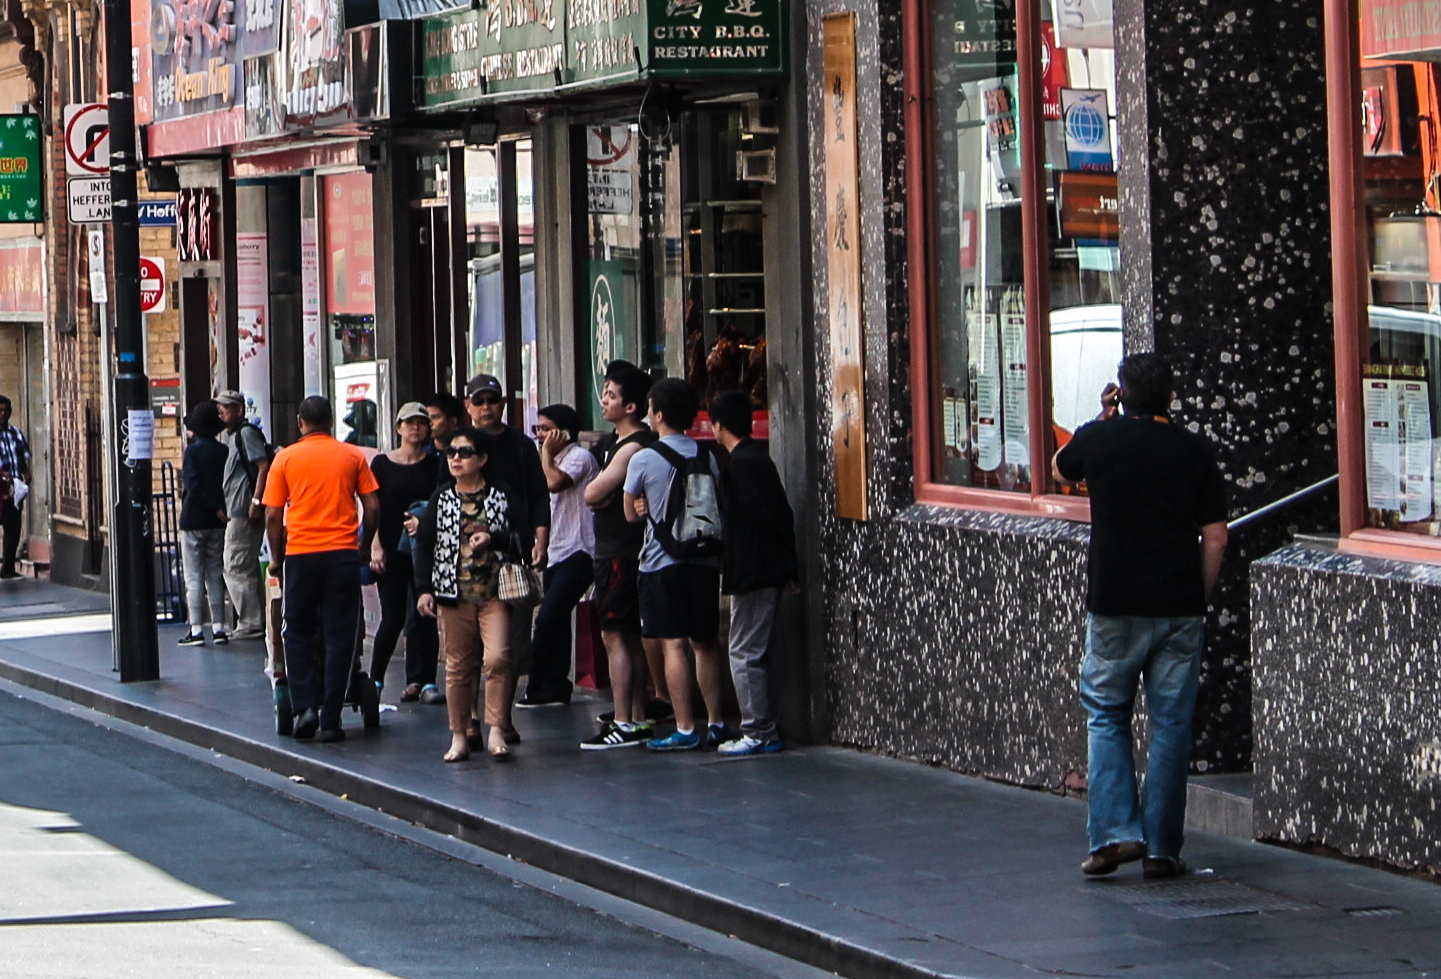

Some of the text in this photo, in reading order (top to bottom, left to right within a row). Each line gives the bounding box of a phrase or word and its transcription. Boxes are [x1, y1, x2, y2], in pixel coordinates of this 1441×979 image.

[654, 25, 770, 39] CITY B.B.Q.
[516, 43, 563, 79] RESTAURANT
[654, 45, 768, 59] RESTAURANT
[175, 66, 204, 102] Ocean
[209, 57, 230, 103] King
